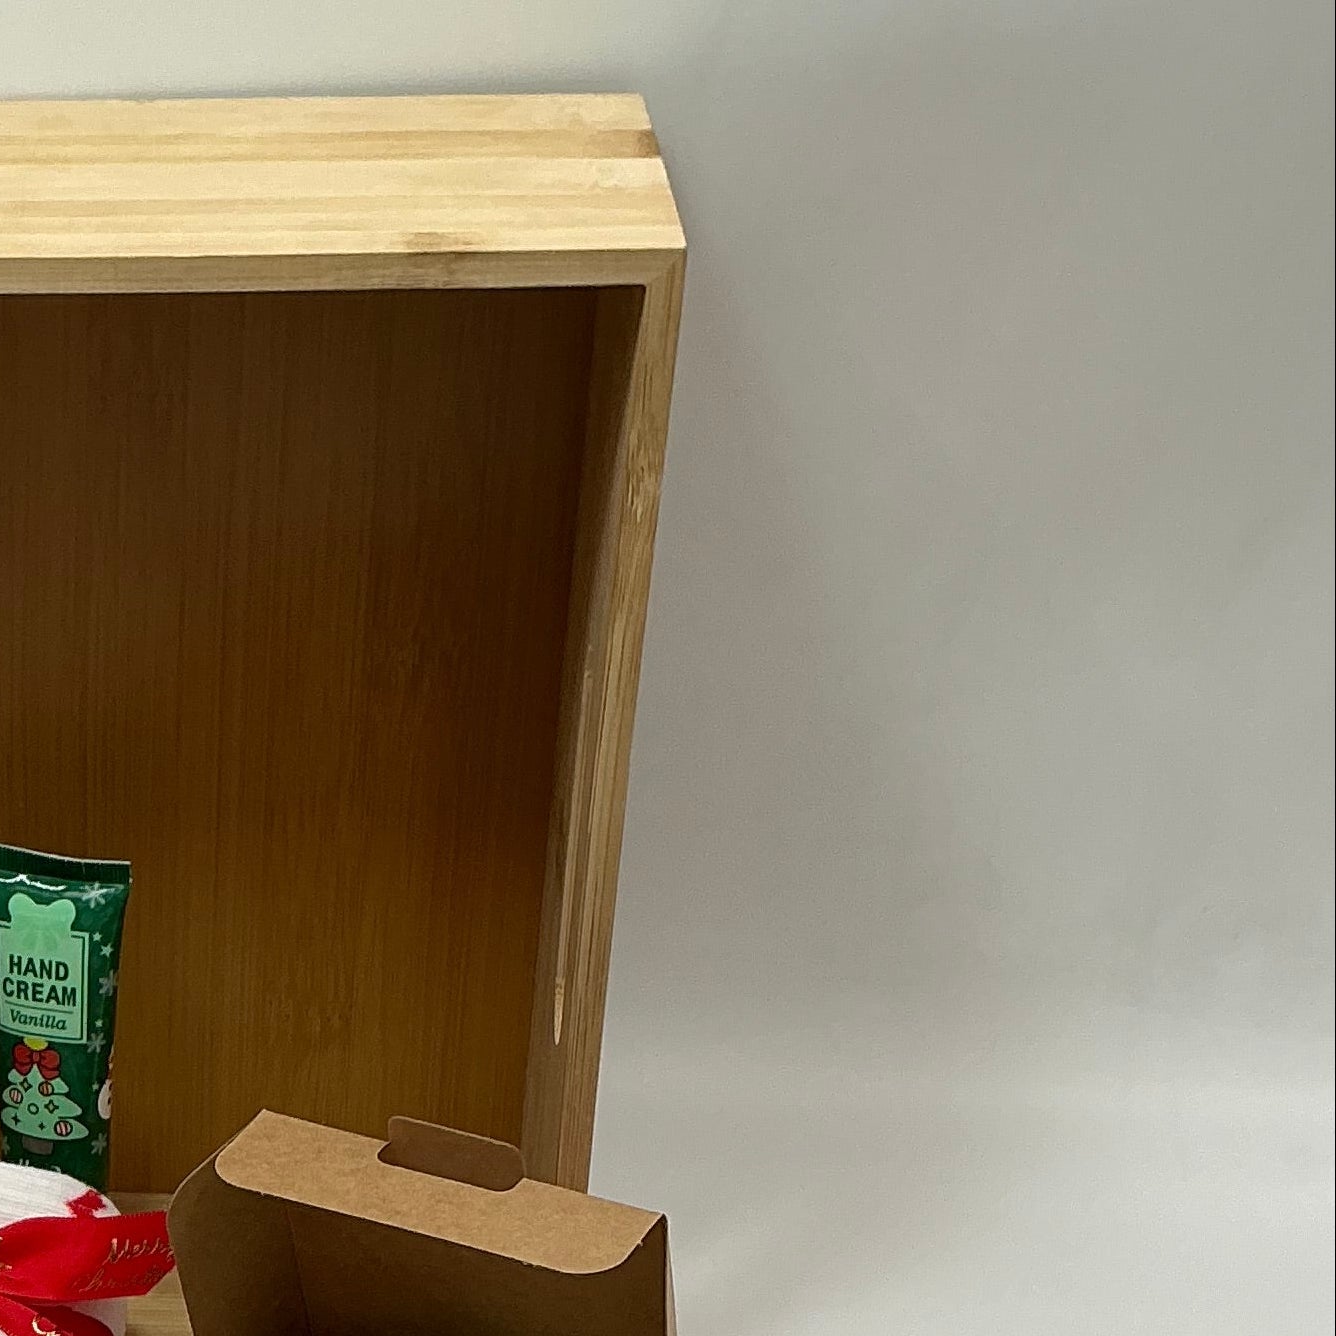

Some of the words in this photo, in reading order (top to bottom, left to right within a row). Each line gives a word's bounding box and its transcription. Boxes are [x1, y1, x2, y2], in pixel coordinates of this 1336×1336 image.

[9, 953, 69, 982] HAND
[2, 977, 77, 1008] CREAM
[9, 1009, 68, 1031] Vanilla
